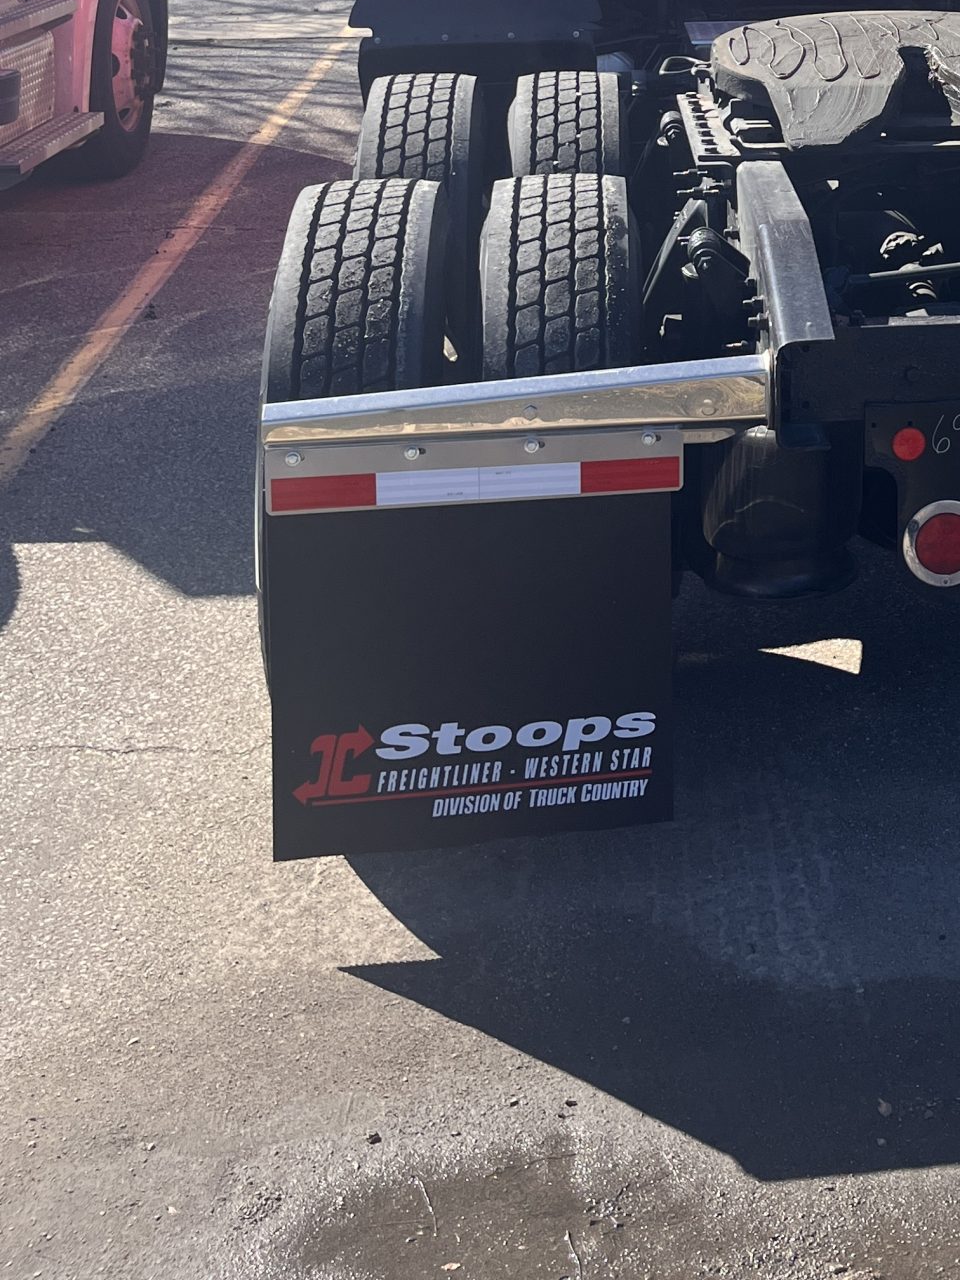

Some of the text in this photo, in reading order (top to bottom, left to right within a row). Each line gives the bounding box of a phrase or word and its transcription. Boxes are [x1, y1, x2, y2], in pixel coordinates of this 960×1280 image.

[375, 711, 657, 761] Stoops
[377, 760, 502, 794] FREIGHTLINER
[524, 750, 602, 780] WESTERN
[610, 746, 653, 772] STAR
[432, 779, 650, 819] DIVISION OF TRUCK COUNTRY
